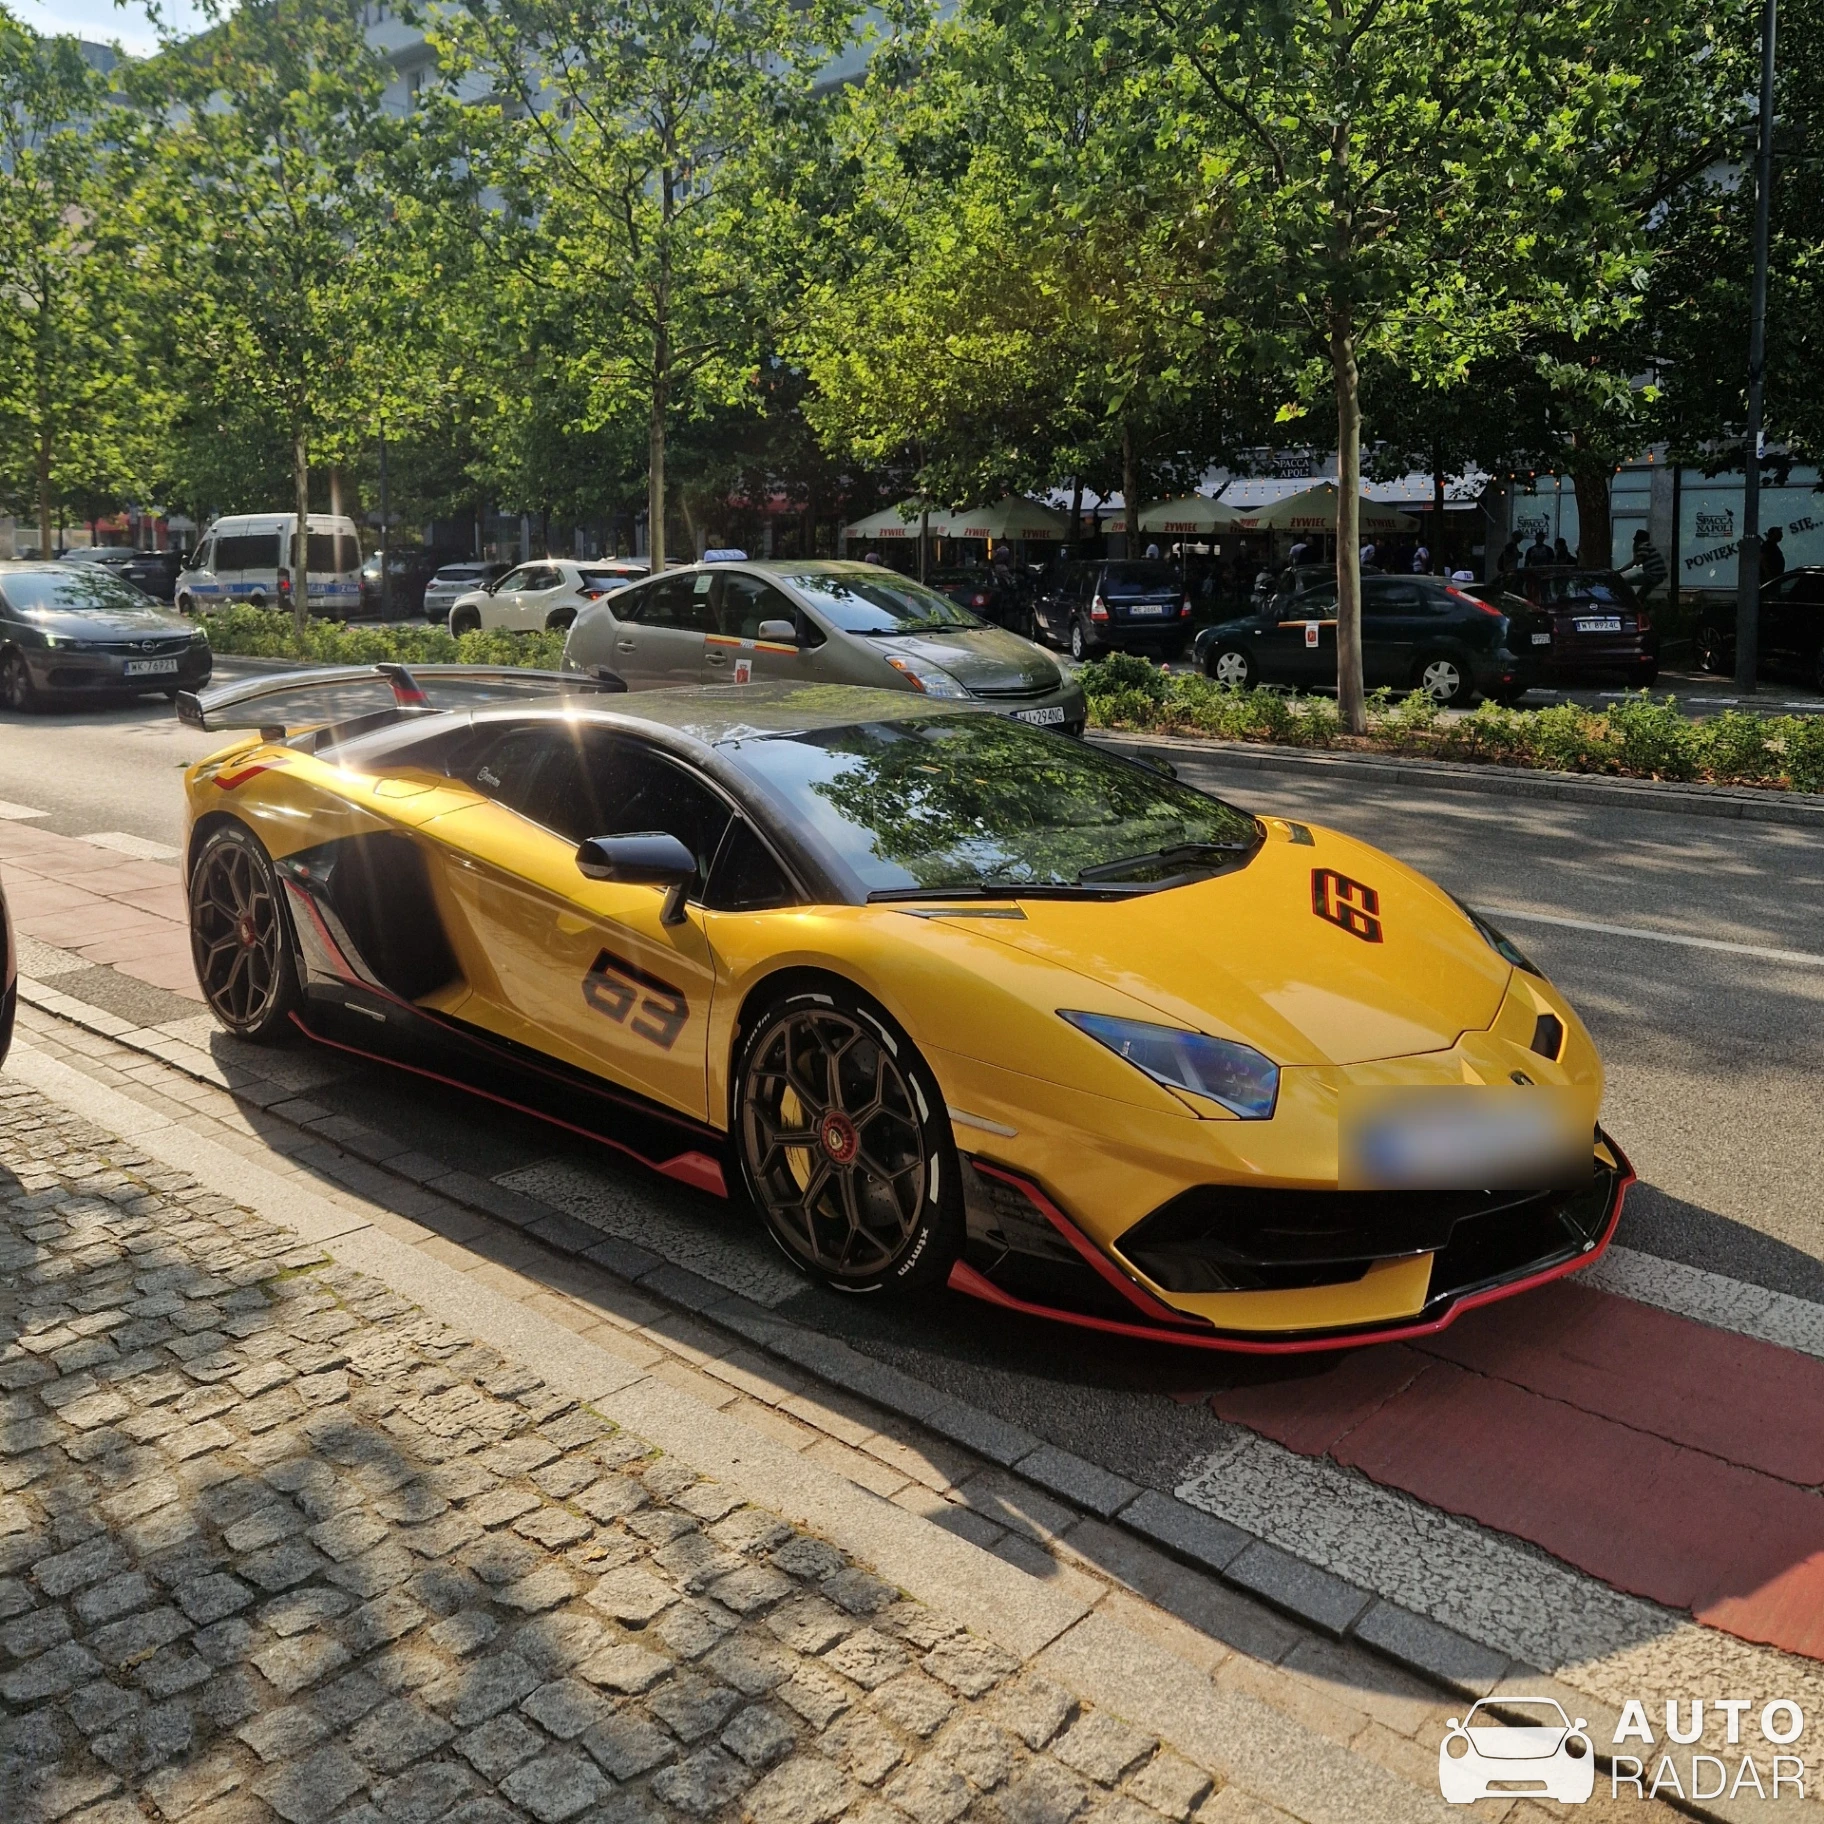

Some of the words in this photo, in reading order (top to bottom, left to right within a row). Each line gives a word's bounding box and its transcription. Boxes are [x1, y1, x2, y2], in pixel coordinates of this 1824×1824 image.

[1273, 452, 1309, 468] SPACCA
[1279, 468, 1309, 478] APOLI
[1290, 517, 1326, 527] ŻYWIEC
[1517, 515, 1549, 528] SPACCA
[1696, 512, 1733, 525] SPACCA
[1165, 521, 1198, 532] ŻYWIEC
[1696, 525, 1733, 533] NAPOLI
[879, 528, 906, 537] ŻYWIEC
[964, 528, 991, 537] ŻYWIEC
[1061, 548, 1068, 557] P
[1311, 867, 1384, 943] 63
[582, 946, 690, 1052] 63
